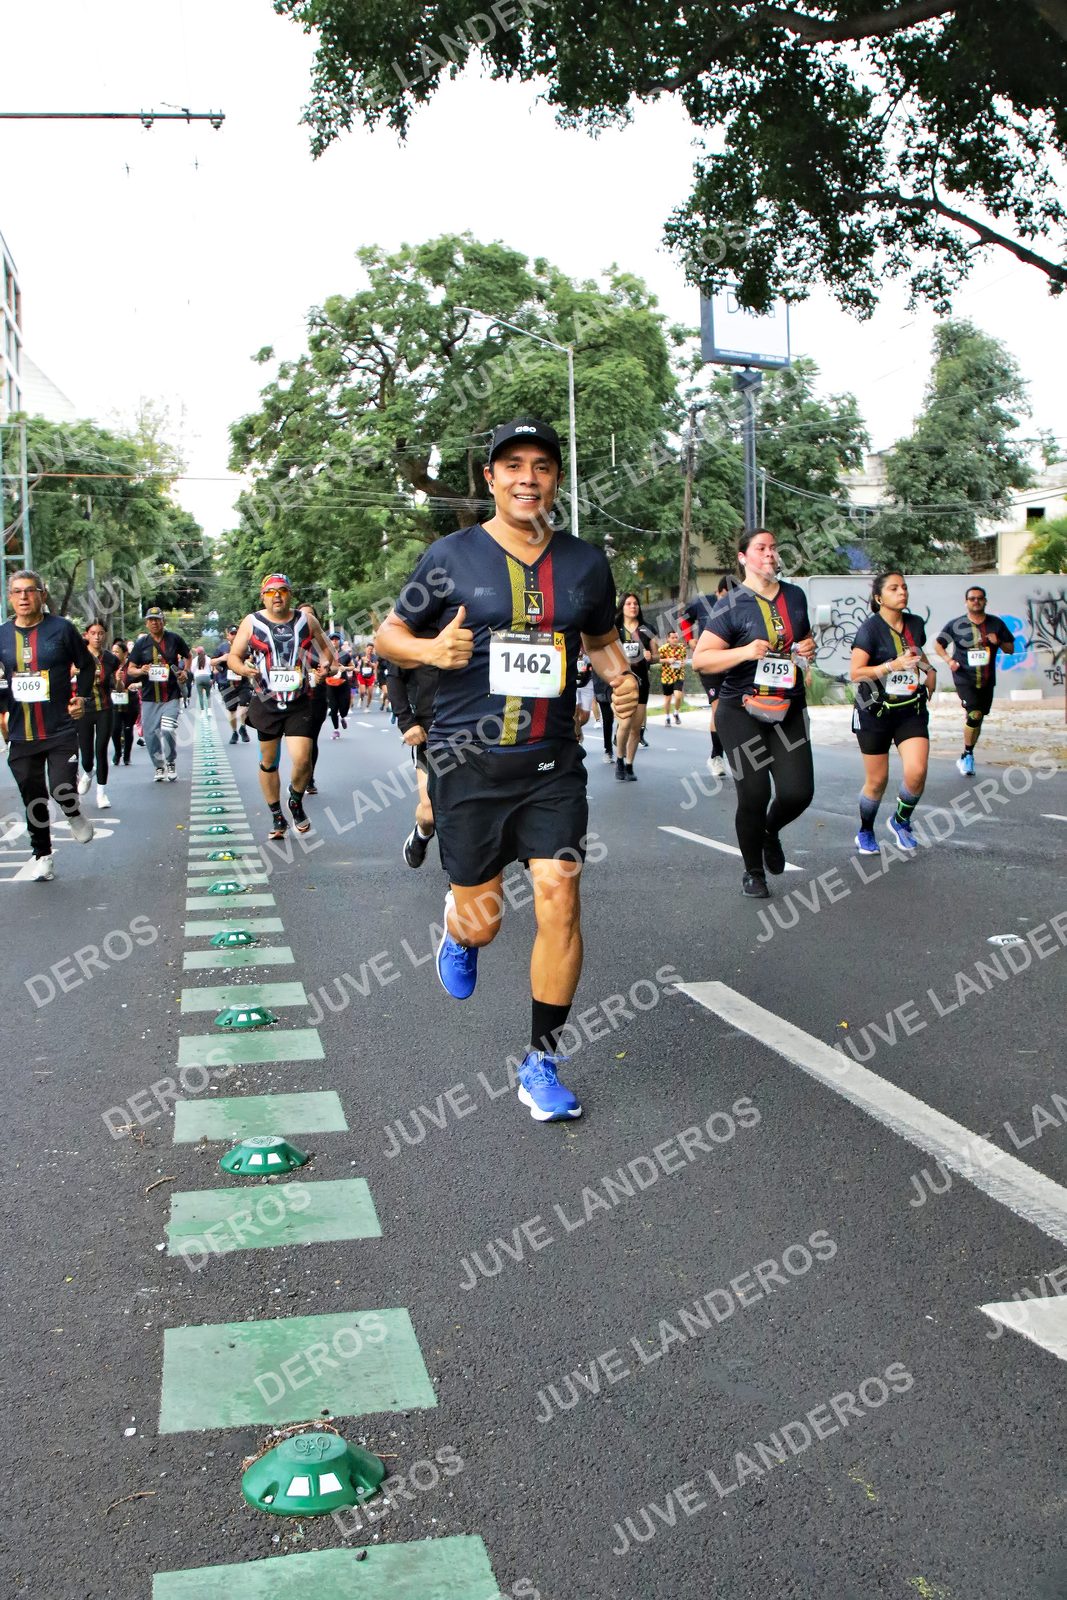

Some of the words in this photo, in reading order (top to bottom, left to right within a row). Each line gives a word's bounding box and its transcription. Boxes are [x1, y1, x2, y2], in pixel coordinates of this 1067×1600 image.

[501, 652, 551, 674] 1462
[763, 662, 789, 675] 6159
[274, 674, 295, 683] 7704
[891, 674, 914, 685] 4925
[17, 681, 41, 691] 5069
